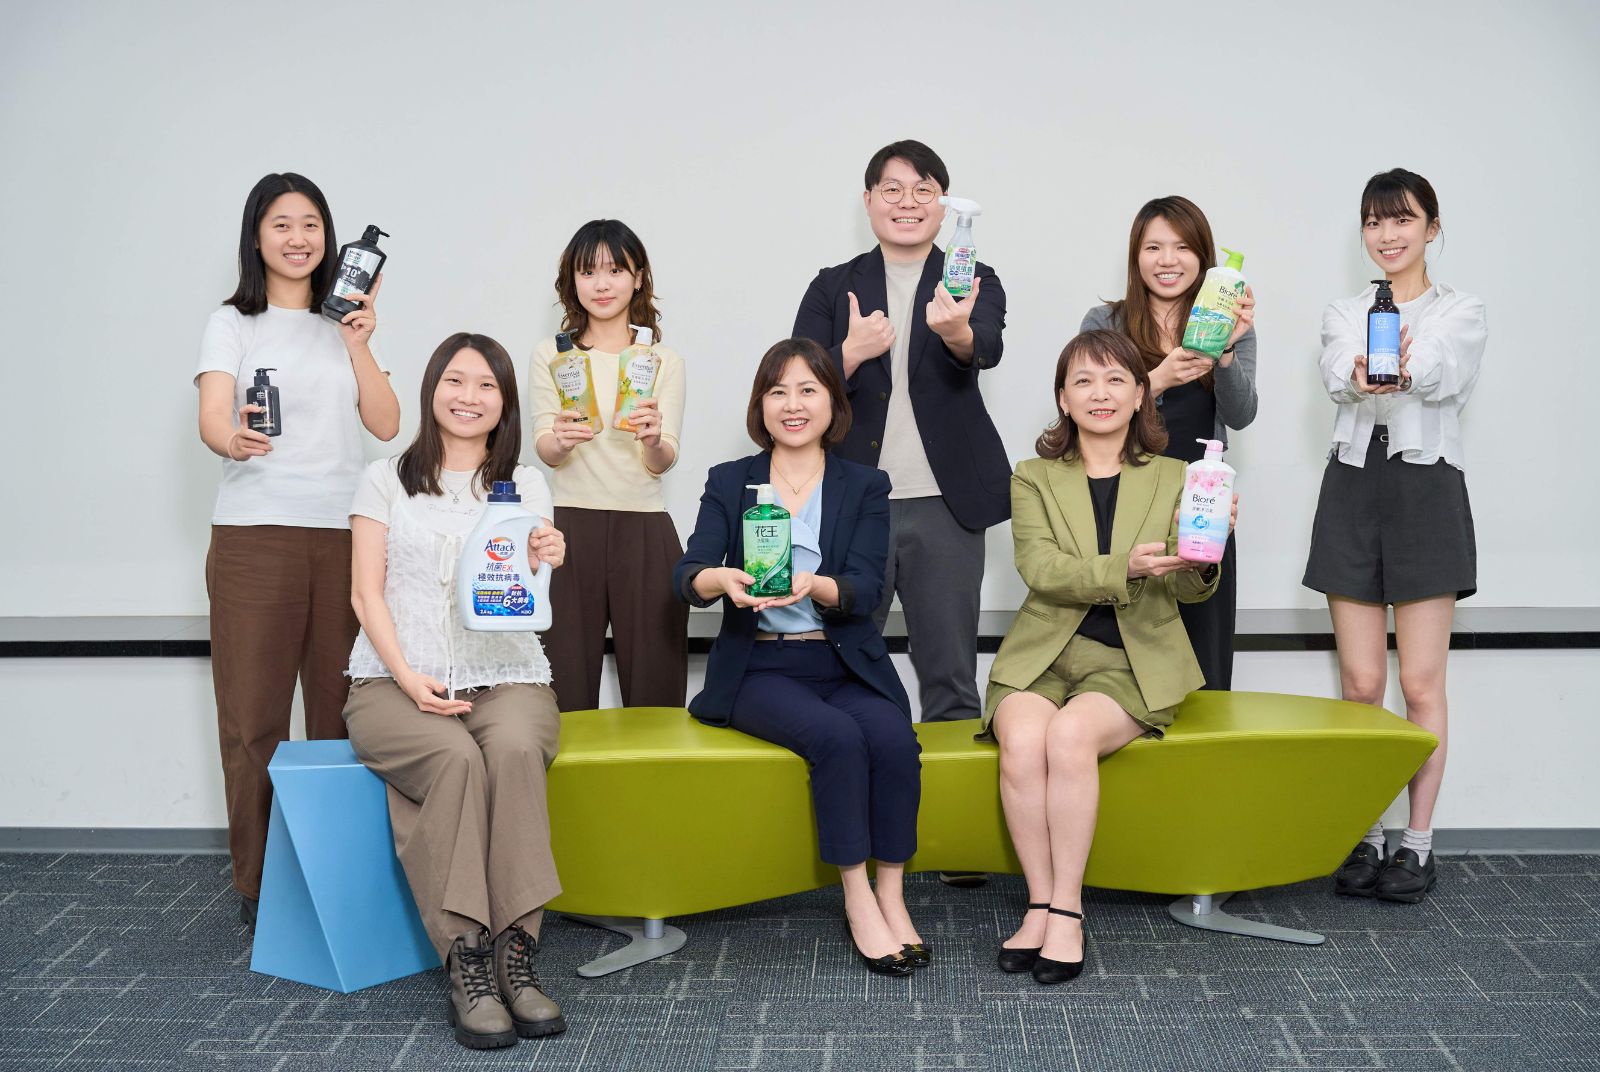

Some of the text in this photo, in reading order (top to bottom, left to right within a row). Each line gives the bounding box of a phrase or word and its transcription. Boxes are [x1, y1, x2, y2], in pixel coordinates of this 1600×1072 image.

[1192, 493, 1216, 505] Bioré
[755, 525, 778, 538] 花王
[484, 539, 516, 552] Attack
[477, 573, 520, 582] 極效抗病毒
